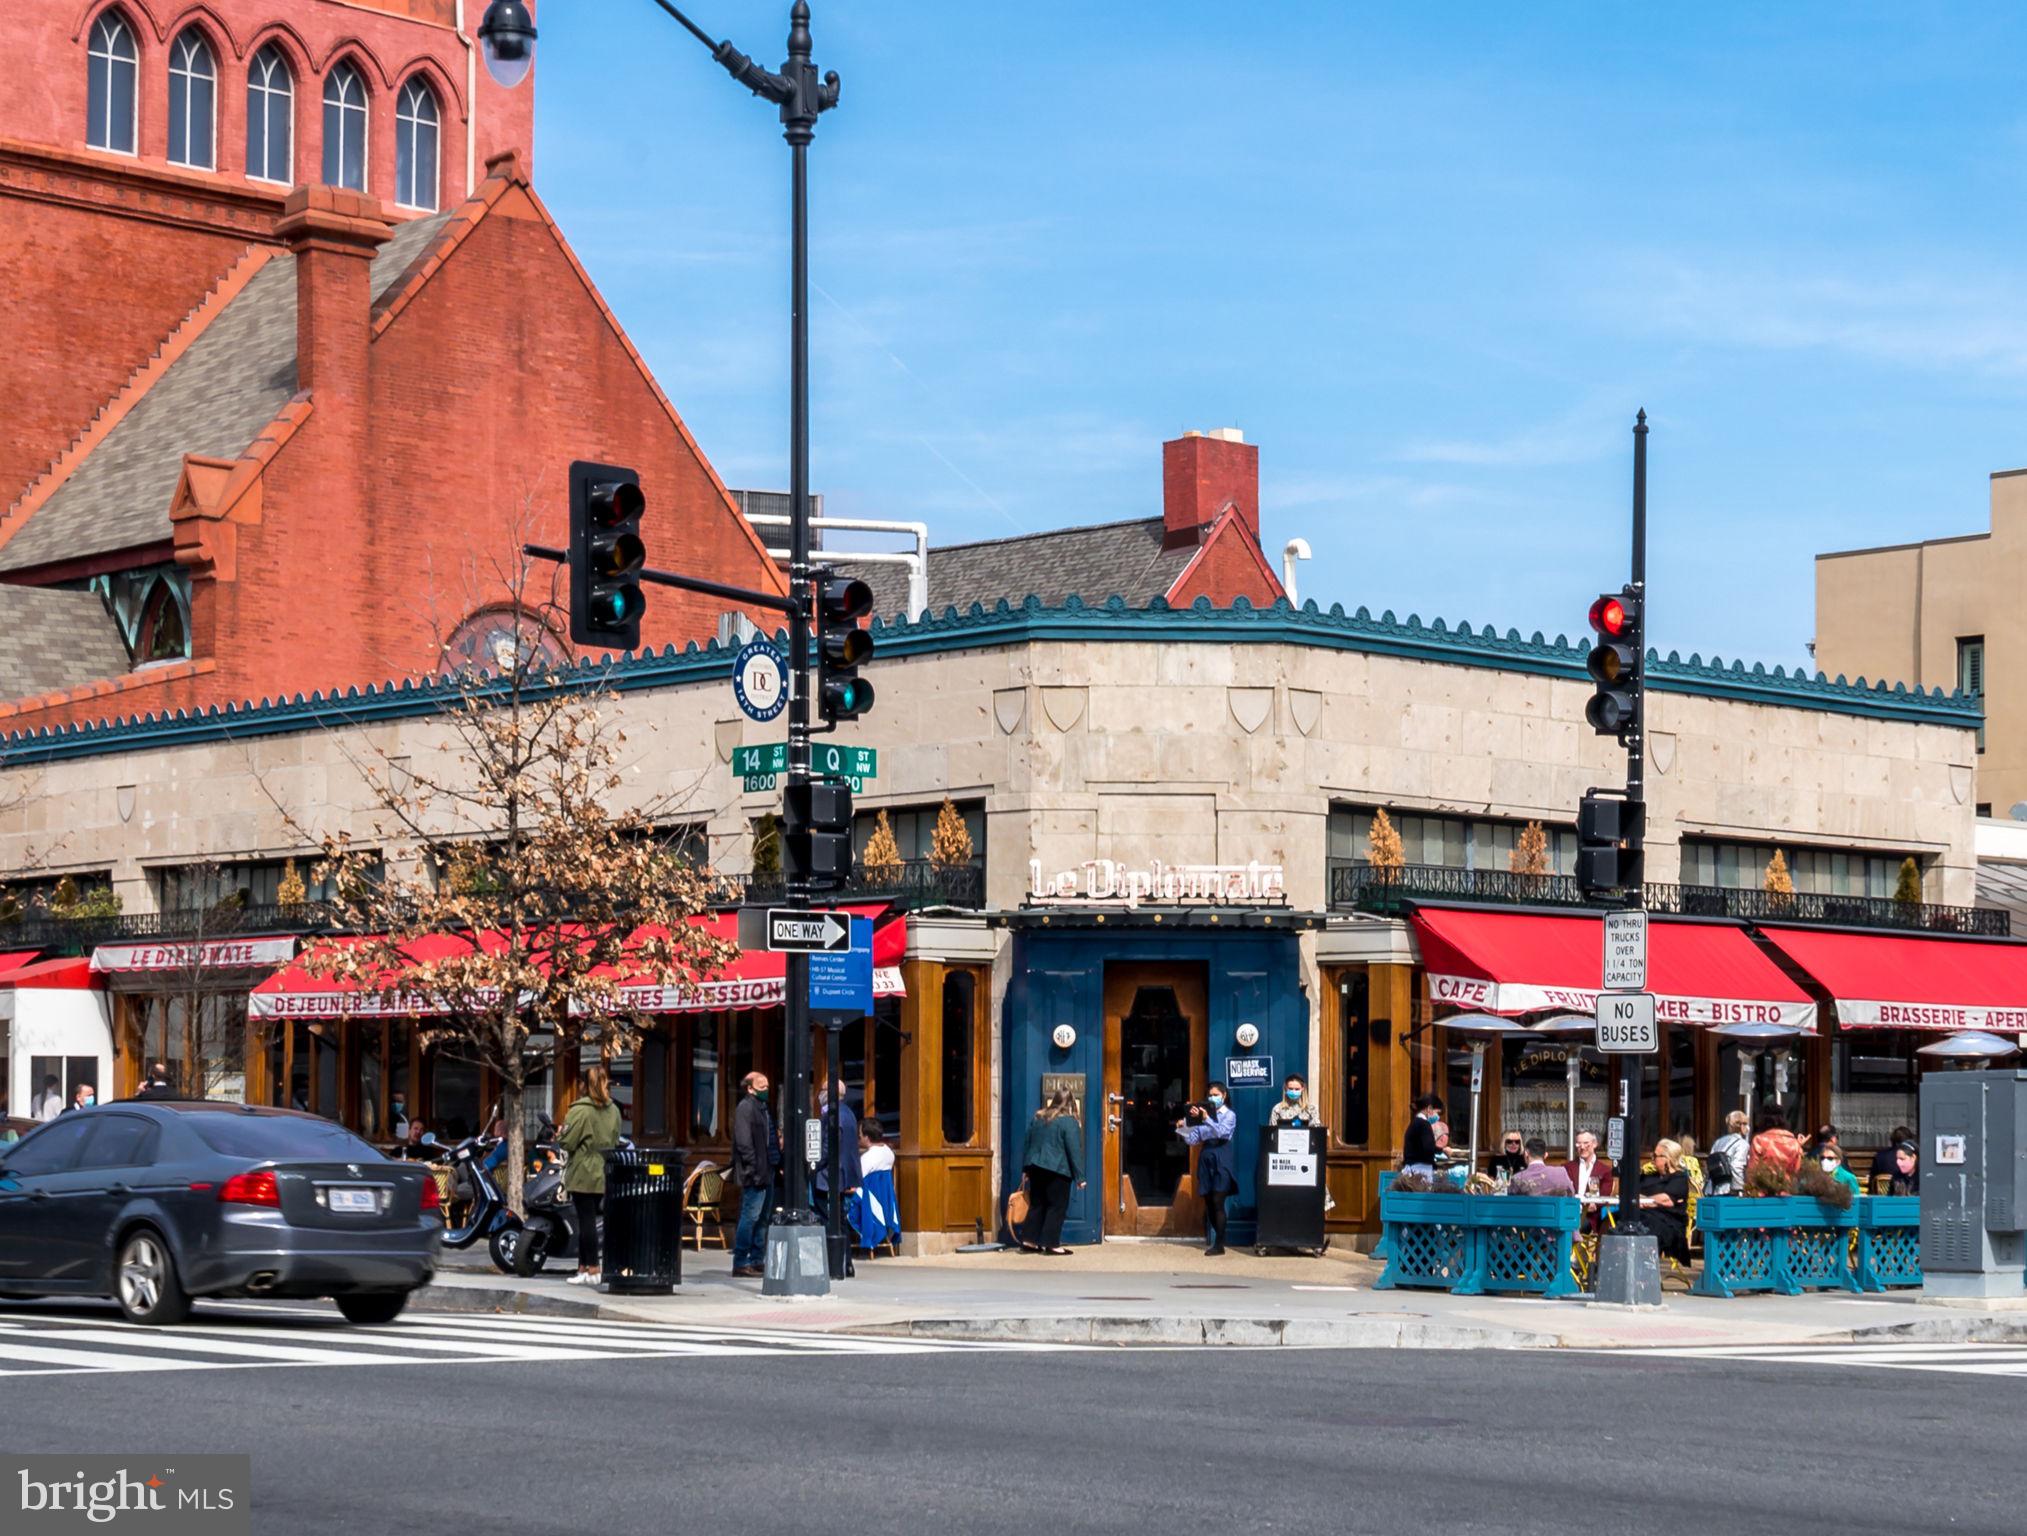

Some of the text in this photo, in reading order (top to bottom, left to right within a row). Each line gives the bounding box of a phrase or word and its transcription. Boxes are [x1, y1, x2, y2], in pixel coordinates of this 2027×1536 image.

[742, 645, 780, 664] GREATER
[753, 672, 772, 692] DC
[737, 689, 785, 718] 14TH STREET
[742, 746, 784, 771] 14 ST
[772, 759, 784, 769] NW
[826, 748, 869, 771] Q ST
[856, 763, 871, 773] NW
[744, 774, 776, 791] 1600
[1029, 859, 1284, 909] Le Diplomate
[777, 923, 825, 939] ONE WAY
[1608, 919, 1642, 929] NO THRU
[1611, 932, 1640, 942] TRUCKS
[131, 950, 149, 965] LE
[1615, 946, 1634, 956] OVER
[1629, 959, 1643, 968] TON
[1606, 972, 1643, 982] CAPACITY
[1438, 978, 1488, 1003] CAFE
[1614, 1003, 1634, 1019] NO
[1655, 1000, 1689, 1018] MER
[1712, 1002, 1782, 1023] BISTRO
[1880, 1005, 1966, 1025] BRASSERIE
[1601, 1026, 1650, 1043] BUSES
[1231, 1060, 1259, 1077] NO MASK
[1243, 1067, 1268, 1077] SERVICE
[1530, 1050, 1600, 1079] DIPLOTE
[1045, 1079, 1083, 1092] MENU
